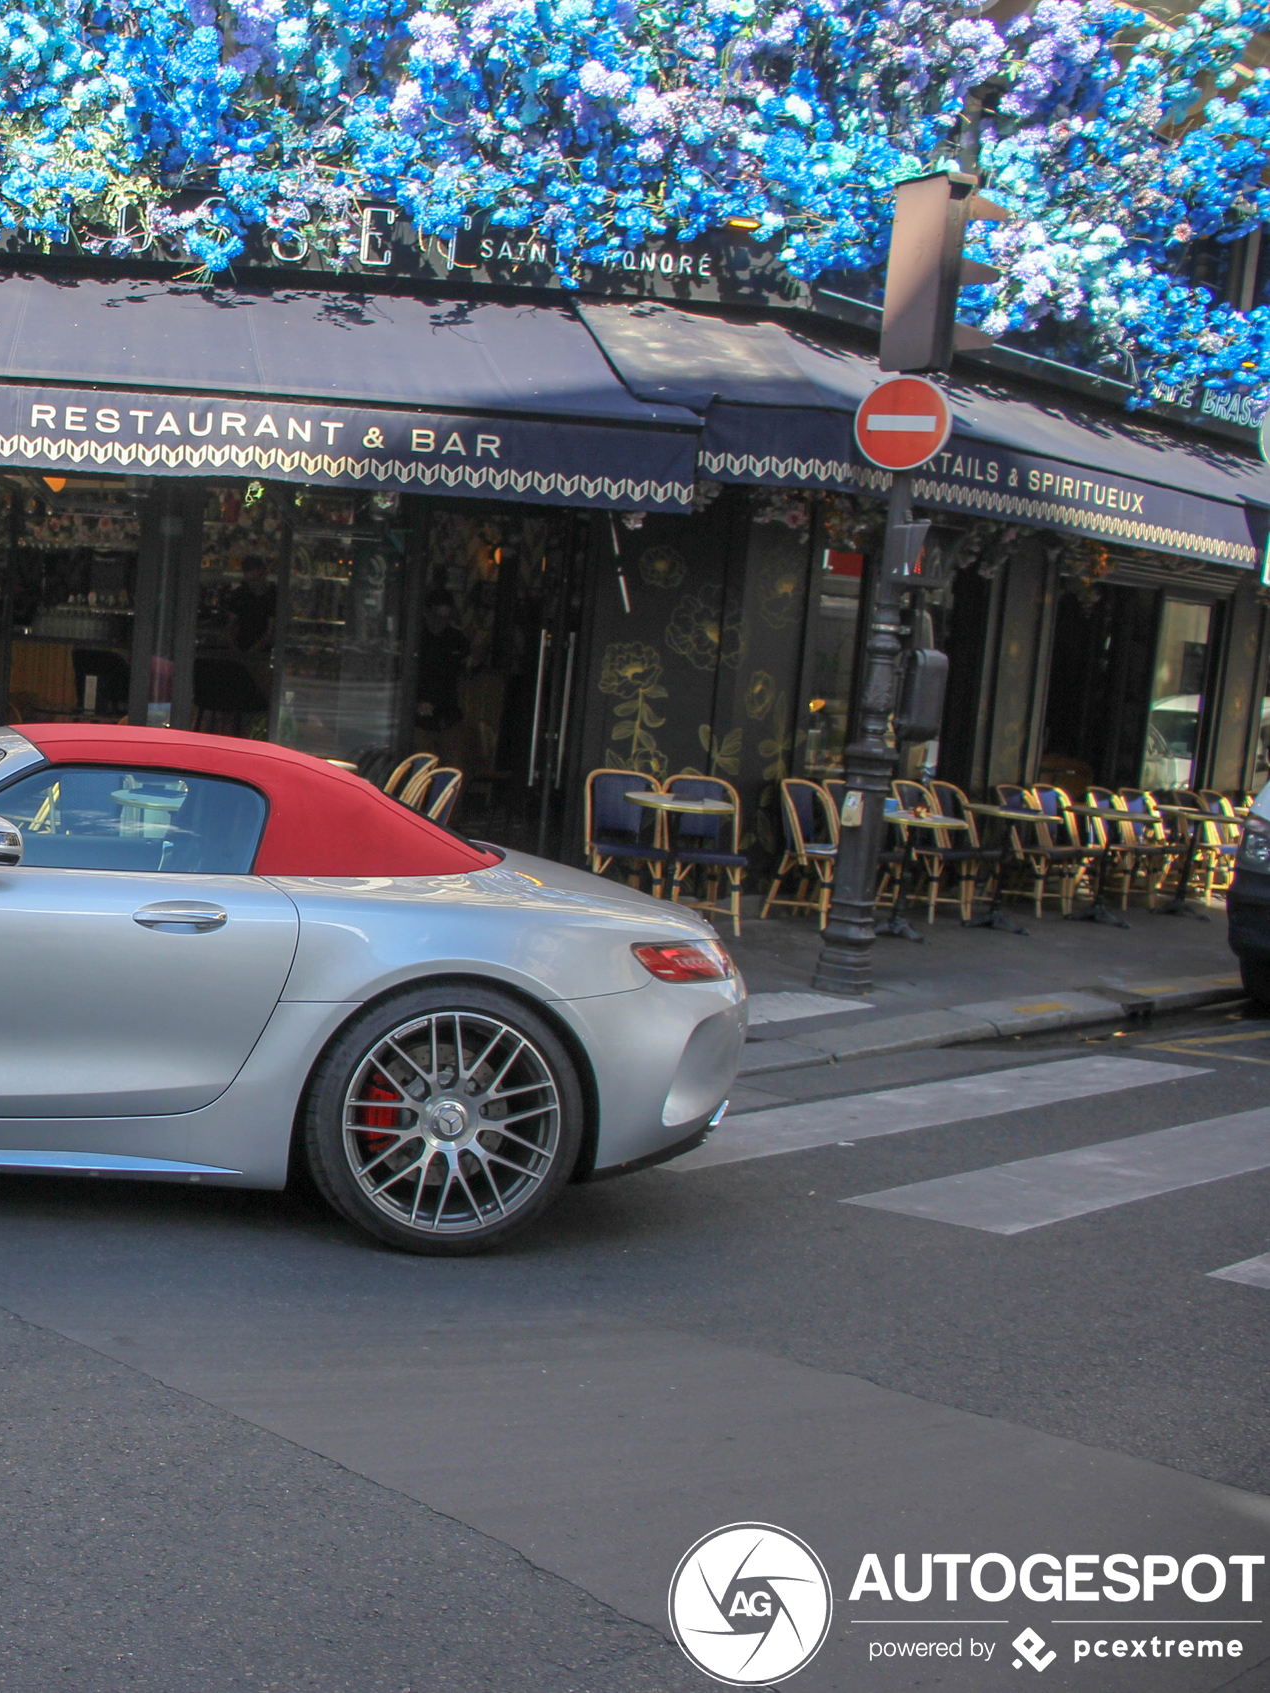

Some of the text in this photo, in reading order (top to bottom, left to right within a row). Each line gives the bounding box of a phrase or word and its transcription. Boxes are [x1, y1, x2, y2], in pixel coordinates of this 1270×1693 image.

[30, 404, 501, 459] RESTAURANT & BAR
[1008, 467, 1019, 487] &
[1028, 469, 1145, 514] SPIRITUEUX
